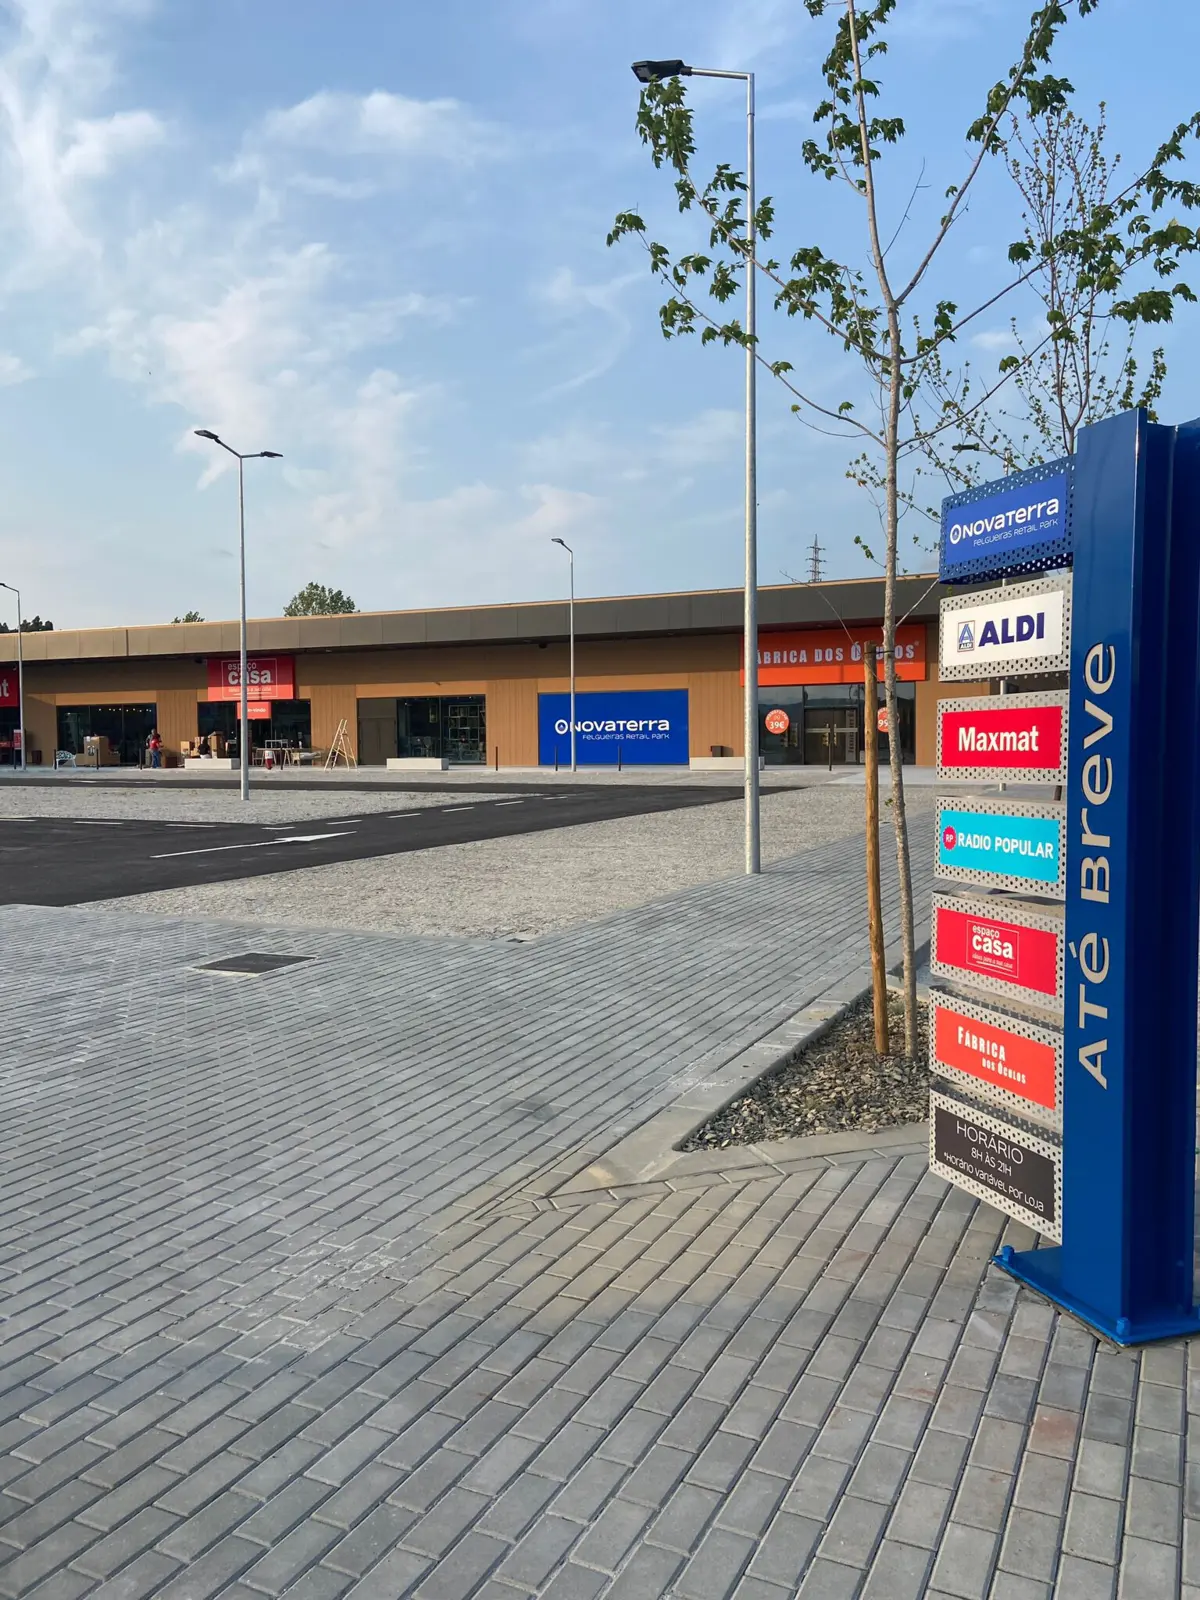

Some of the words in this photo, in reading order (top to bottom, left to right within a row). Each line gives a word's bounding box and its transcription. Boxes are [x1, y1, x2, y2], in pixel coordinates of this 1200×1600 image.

[978, 612, 1045, 647] ALDI
[757, 649, 807, 665] ÁBRICA
[815, 647, 844, 662] DOS
[851, 641, 914, 661] ÓUOS
[228, 663, 257, 671] espço
[958, 725, 1039, 751] Maxmat
[1080, 643, 1116, 904] Breve
[958, 832, 991, 851] RADIO
[994, 836, 1054, 859] POPULAR
[972, 925, 1000, 939] espaço
[972, 934, 1013, 959] casa
[957, 1026, 1006, 1061] FÁBRICA
[982, 1057, 996, 1071] DOS
[997, 1061, 1026, 1084] ÓCULOS
[956, 1120, 1023, 1164] HORÁRIO
[971, 1147, 983, 1161] 8H
[985, 1152, 996, 1168] ÀS
[997, 1160, 1012, 1176] 21H
[975, 1167, 1008, 1192] variável
